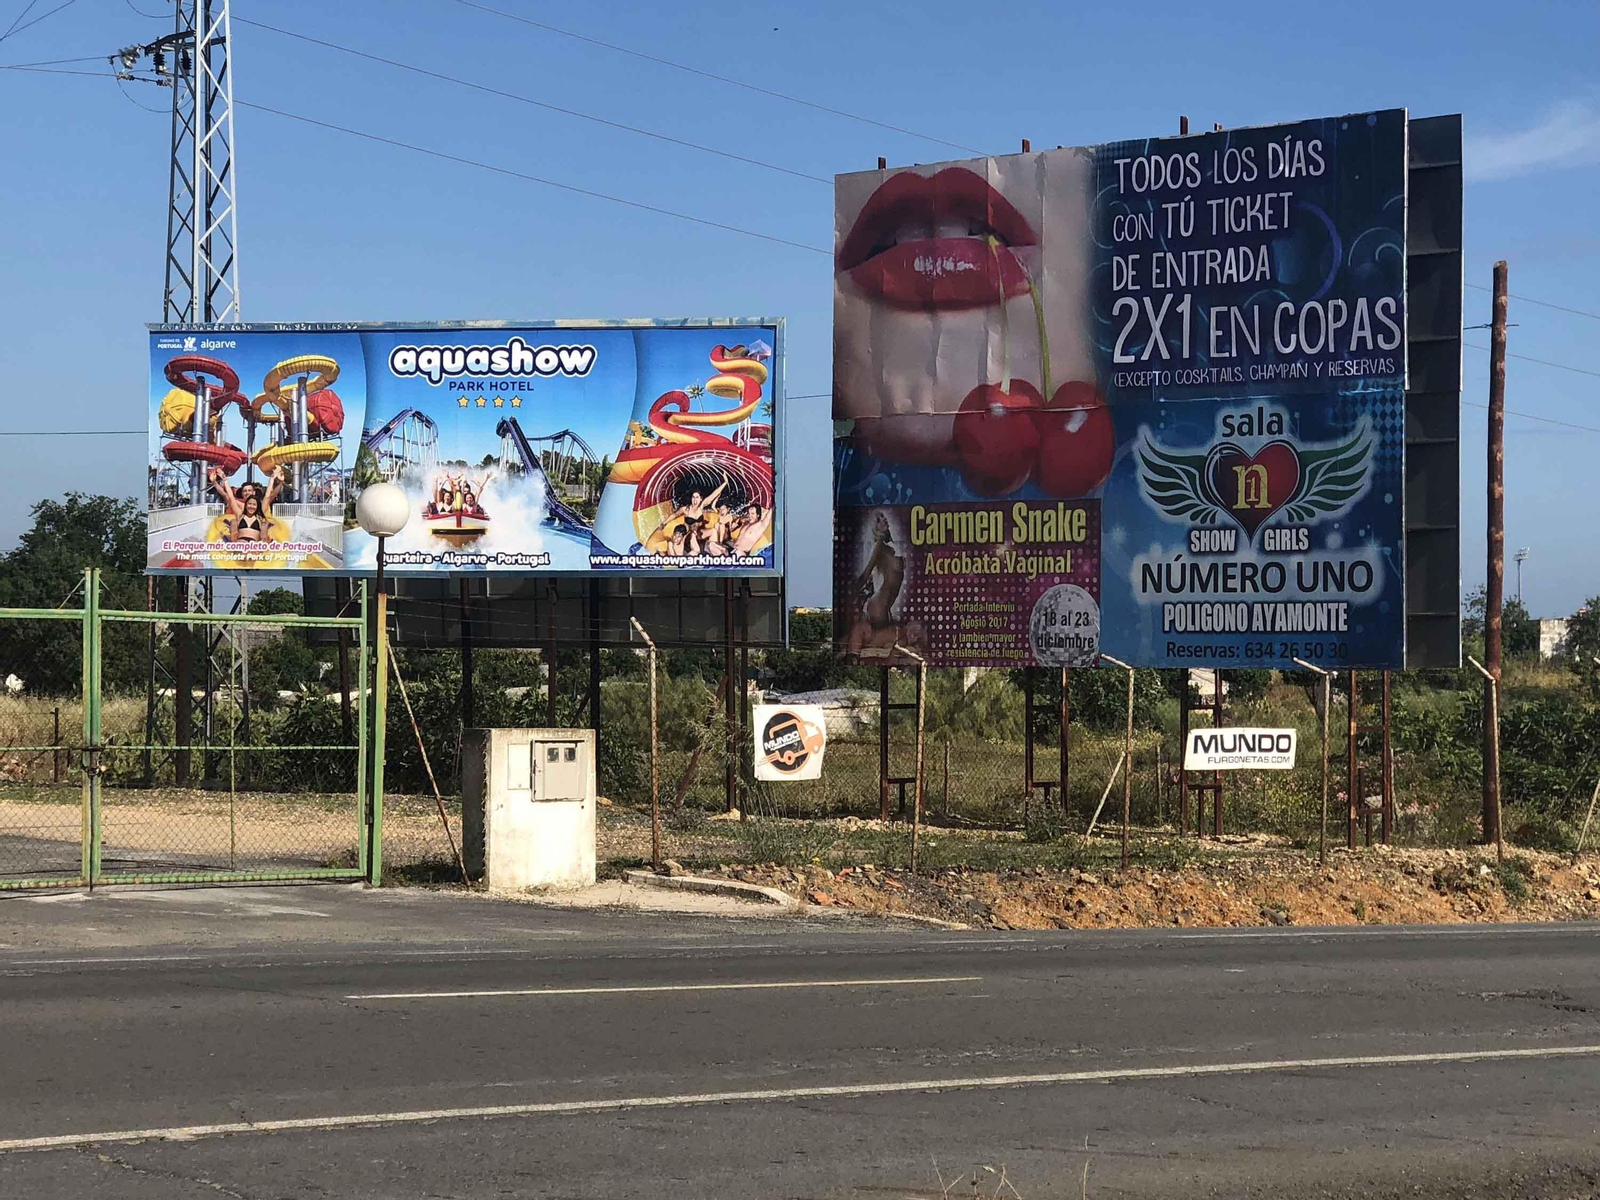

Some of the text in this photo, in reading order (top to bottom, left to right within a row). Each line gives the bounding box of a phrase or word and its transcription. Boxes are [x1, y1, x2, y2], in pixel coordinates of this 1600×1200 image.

[1114, 134, 1326, 194] TODOS LOS DÍAS
[1113, 192, 1293, 242] CON TÚ TICKET
[1112, 244, 1271, 291] DE ENTRADA
[1112, 293, 1401, 364] 2X1 EN COPAS
[200, 338, 236, 350] algarve
[391, 338, 595, 385] aquashow
[1114, 370, 1171, 388] (EXCEPTO
[1250, 362, 1308, 380] CHAMPAN
[1314, 361, 1324, 378] Y
[449, 382, 534, 391] PARK HOTEL
[1222, 406, 1284, 438] sala
[910, 502, 1087, 546] Carmen Snake
[163, 542, 172, 550] El
[174, 542, 205, 552] Parque
[226, 542, 268, 552] completo
[270, 542, 280, 550] de
[282, 542, 321, 552] Portugal
[1190, 528, 1309, 552] SHOW GIRLS
[177, 552, 191, 560] The
[264, 554, 274, 562] of
[274, 553, 308, 562] Portugal
[442, 552, 487, 566] Algarve
[498, 552, 550, 567] Portugal
[590, 554, 764, 566] www.aquashowparkhotel.com
[924, 550, 1072, 580] Acróbata Vaginal
[1141, 554, 1374, 594] NÚMERO UNO
[954, 602, 1015, 612] Portada Interviu
[1164, 602, 1348, 632] POLIGONO AYAMONTE
[960, 616, 1008, 629] Agosto 2017
[1043, 612, 1090, 626] 18 al 23
[992, 634, 1016, 645] mayor
[1038, 632, 1094, 648] diciembre
[947, 647, 988, 658] resistencia
[990, 647, 1000, 658] de
[1166, 642, 1240, 658] Reservas:
[1245, 642, 1275, 658] 634
[1280, 642, 1299, 658] 26
[1304, 642, 1324, 658] 50
[764, 730, 800, 750] MUNDO
[1194, 734, 1292, 754] MUNDO
